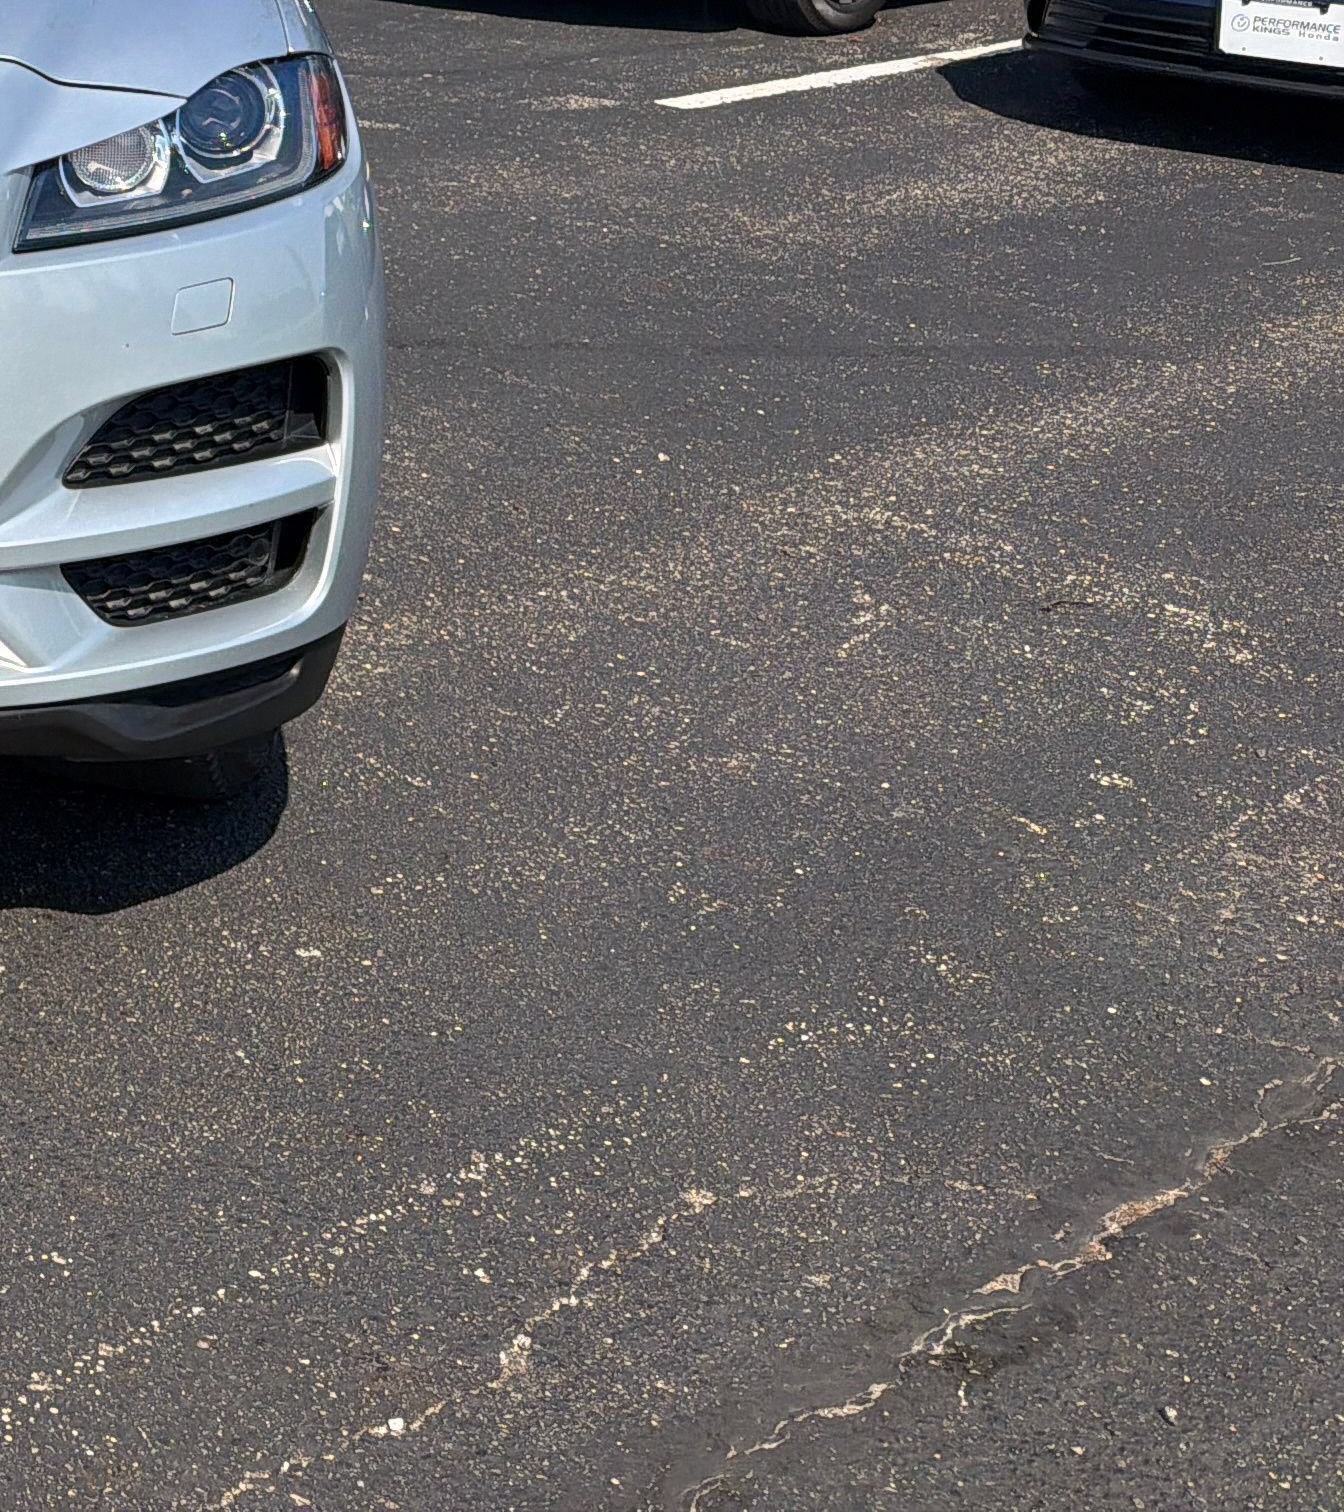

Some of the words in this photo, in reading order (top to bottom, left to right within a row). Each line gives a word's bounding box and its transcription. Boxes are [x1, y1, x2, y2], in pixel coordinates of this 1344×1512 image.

[1253, 16, 1341, 34] PERFORMANCE
[1252, 26, 1290, 36] KINGS
[1299, 30, 1339, 42] Honda
